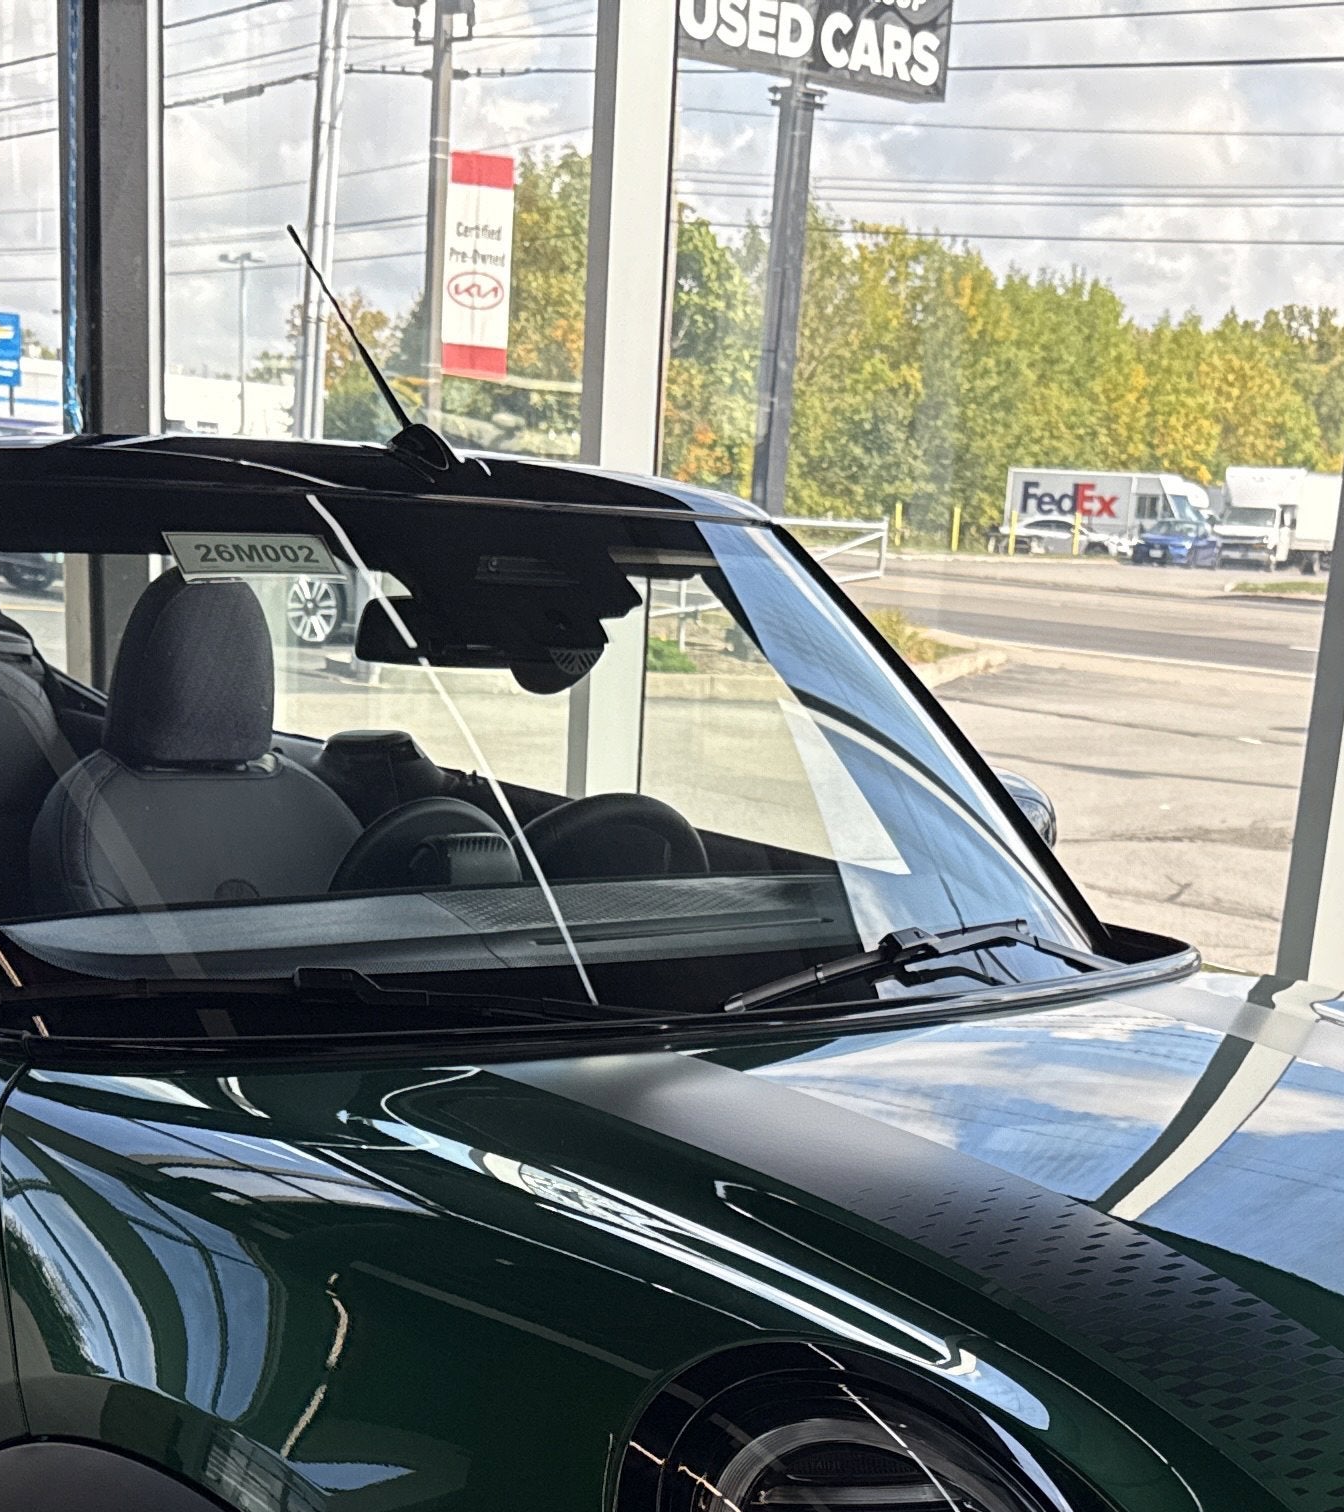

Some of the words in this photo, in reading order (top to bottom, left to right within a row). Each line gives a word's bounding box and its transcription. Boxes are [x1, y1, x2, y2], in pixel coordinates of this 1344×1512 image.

[679, 0, 814, 58] USED
[821, 12, 941, 86] CARS
[456, 221, 502, 241] Certified
[1020, 481, 1121, 518] FedEx
[193, 543, 320, 564] 26M002
